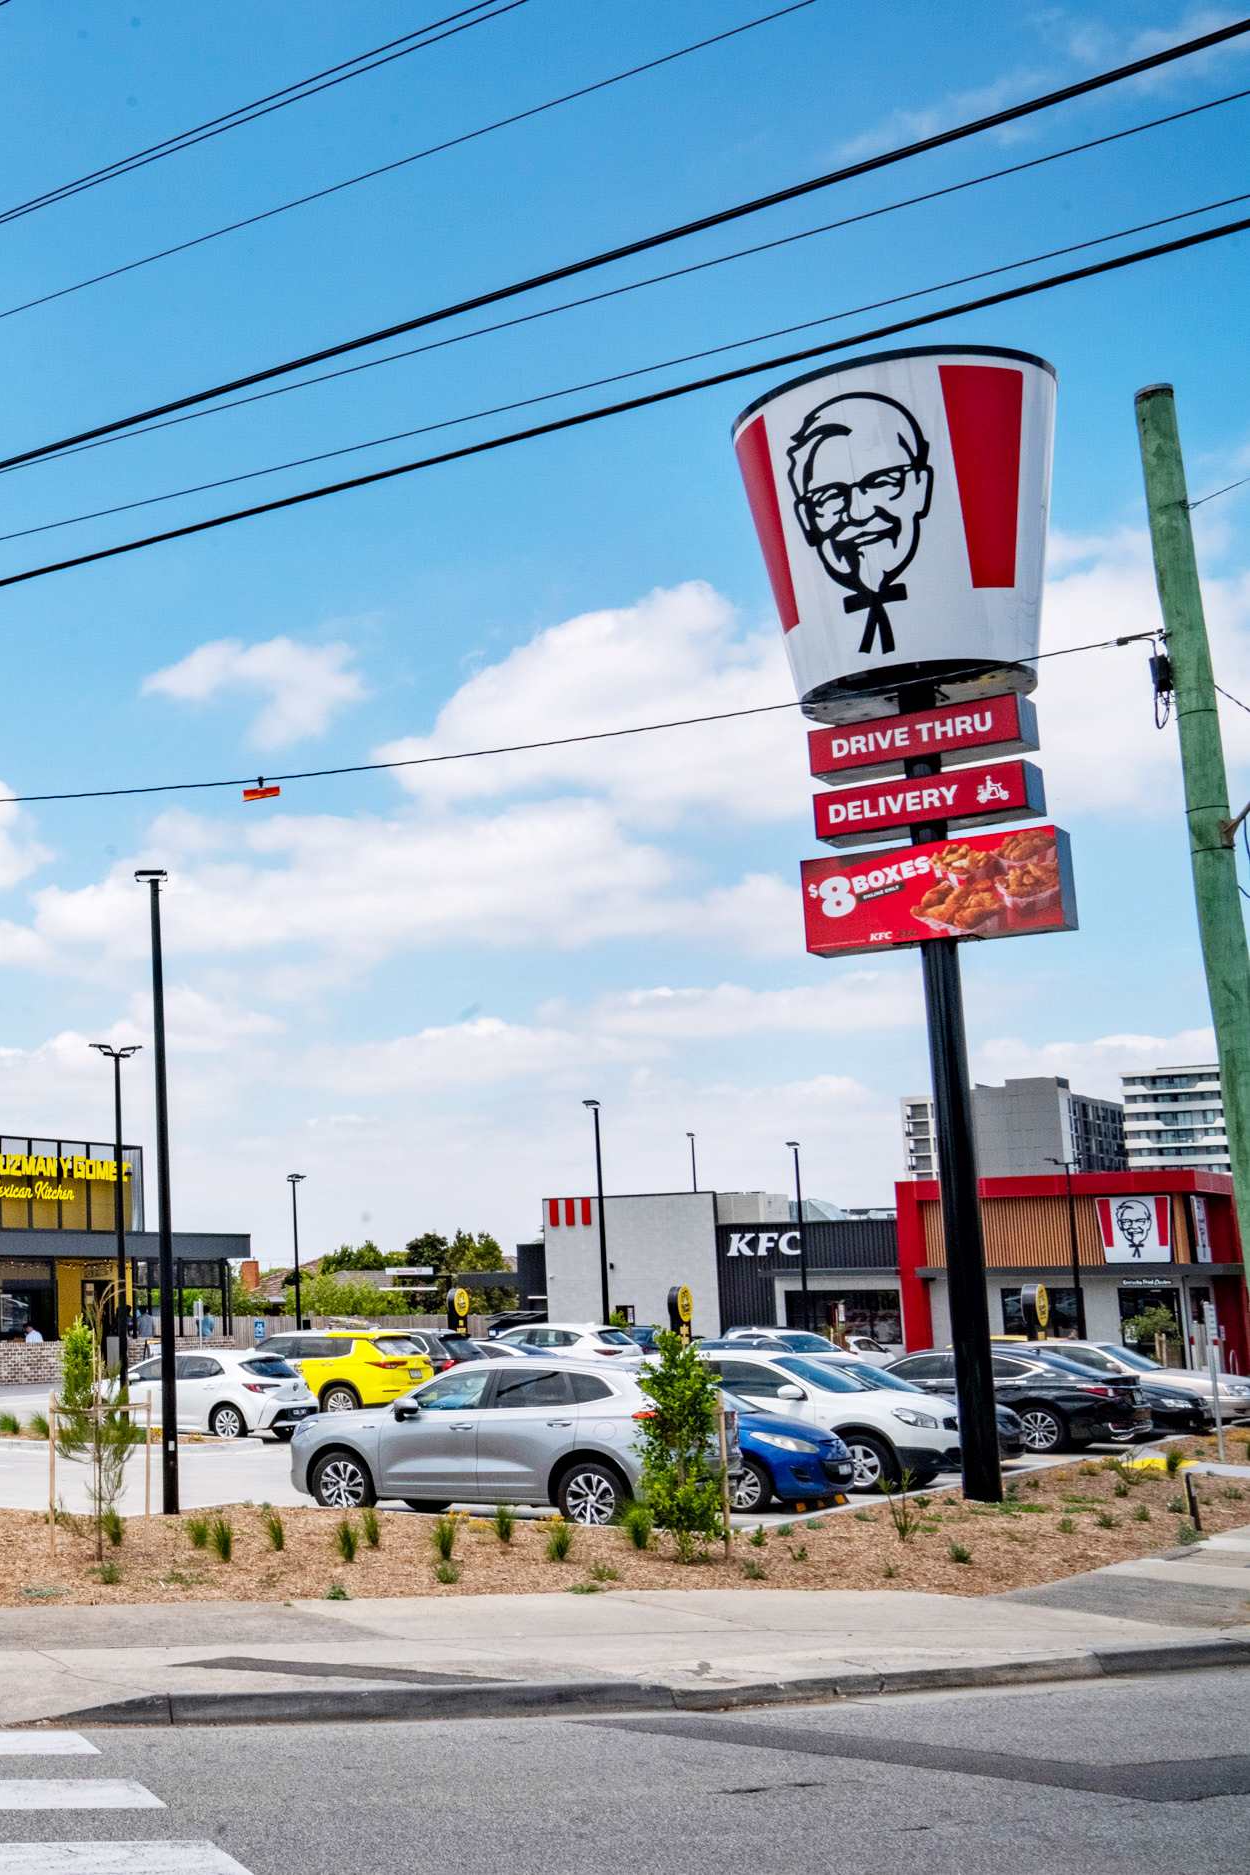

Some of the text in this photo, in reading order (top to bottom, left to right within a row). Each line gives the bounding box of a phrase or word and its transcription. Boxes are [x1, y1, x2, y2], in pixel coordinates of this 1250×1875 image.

[832, 711, 992, 759] DRIVE THRU
[828, 784, 958, 824] DELIVERY
[851, 856, 931, 893] BOXES
[870, 931, 893, 942] KFC
[59, 1155, 72, 1179] Y
[35, 1181, 75, 1200] Kitchen
[726, 1231, 802, 1257] KFC
